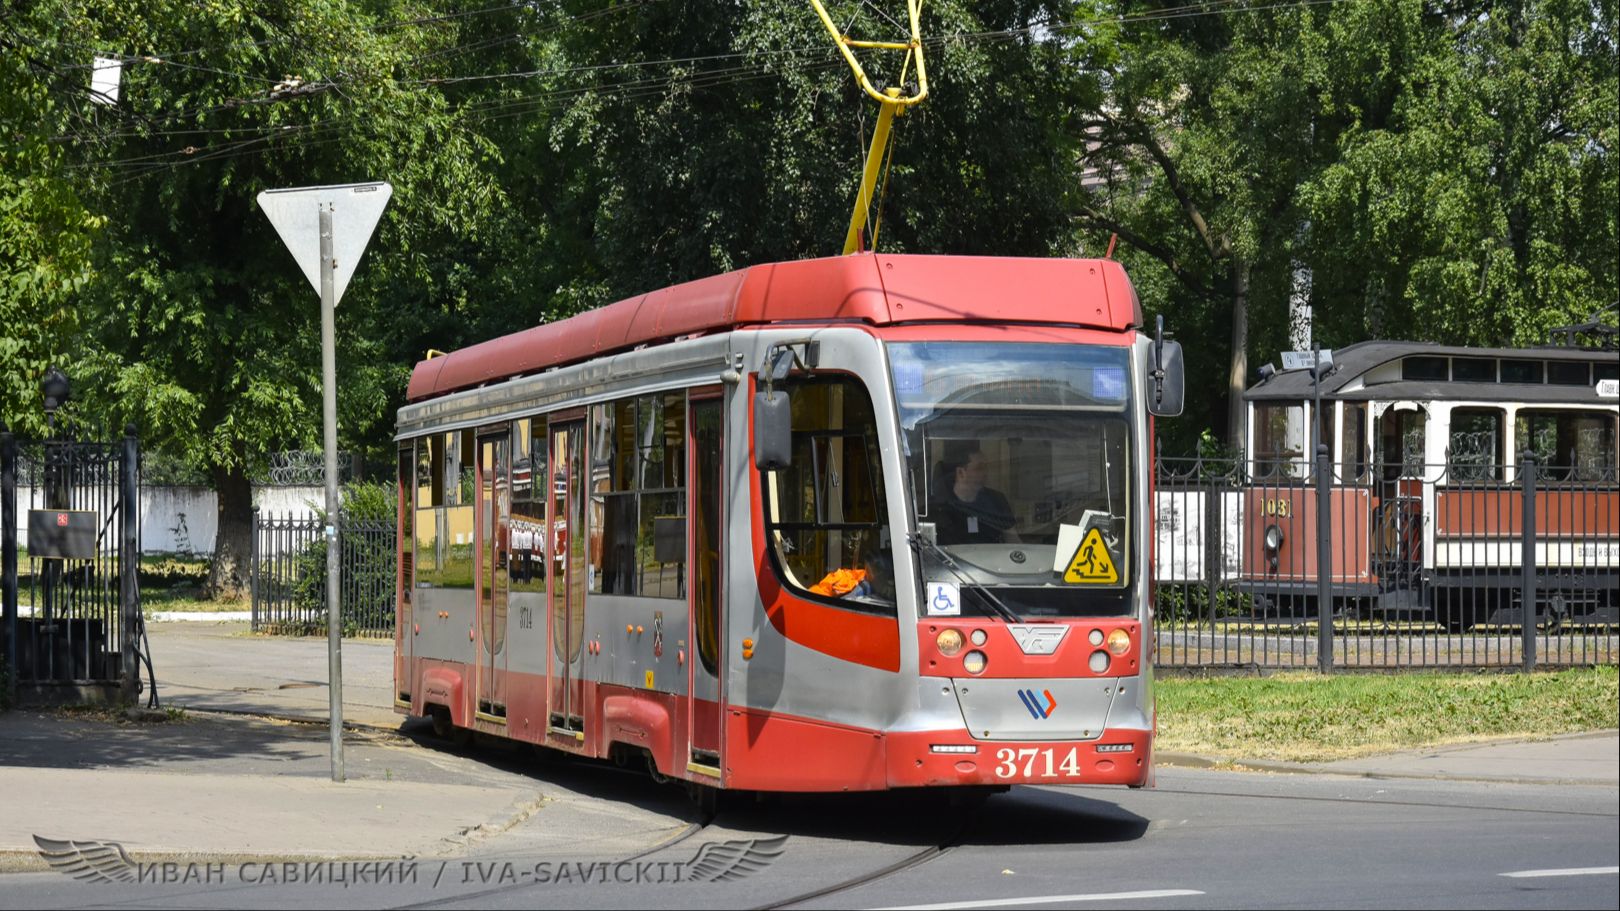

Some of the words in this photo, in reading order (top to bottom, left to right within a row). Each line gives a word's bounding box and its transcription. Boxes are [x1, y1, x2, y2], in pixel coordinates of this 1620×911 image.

[1260, 498, 1292, 517] 1031
[519, 606, 533, 630] 3714
[995, 747, 1080, 778] 3714
